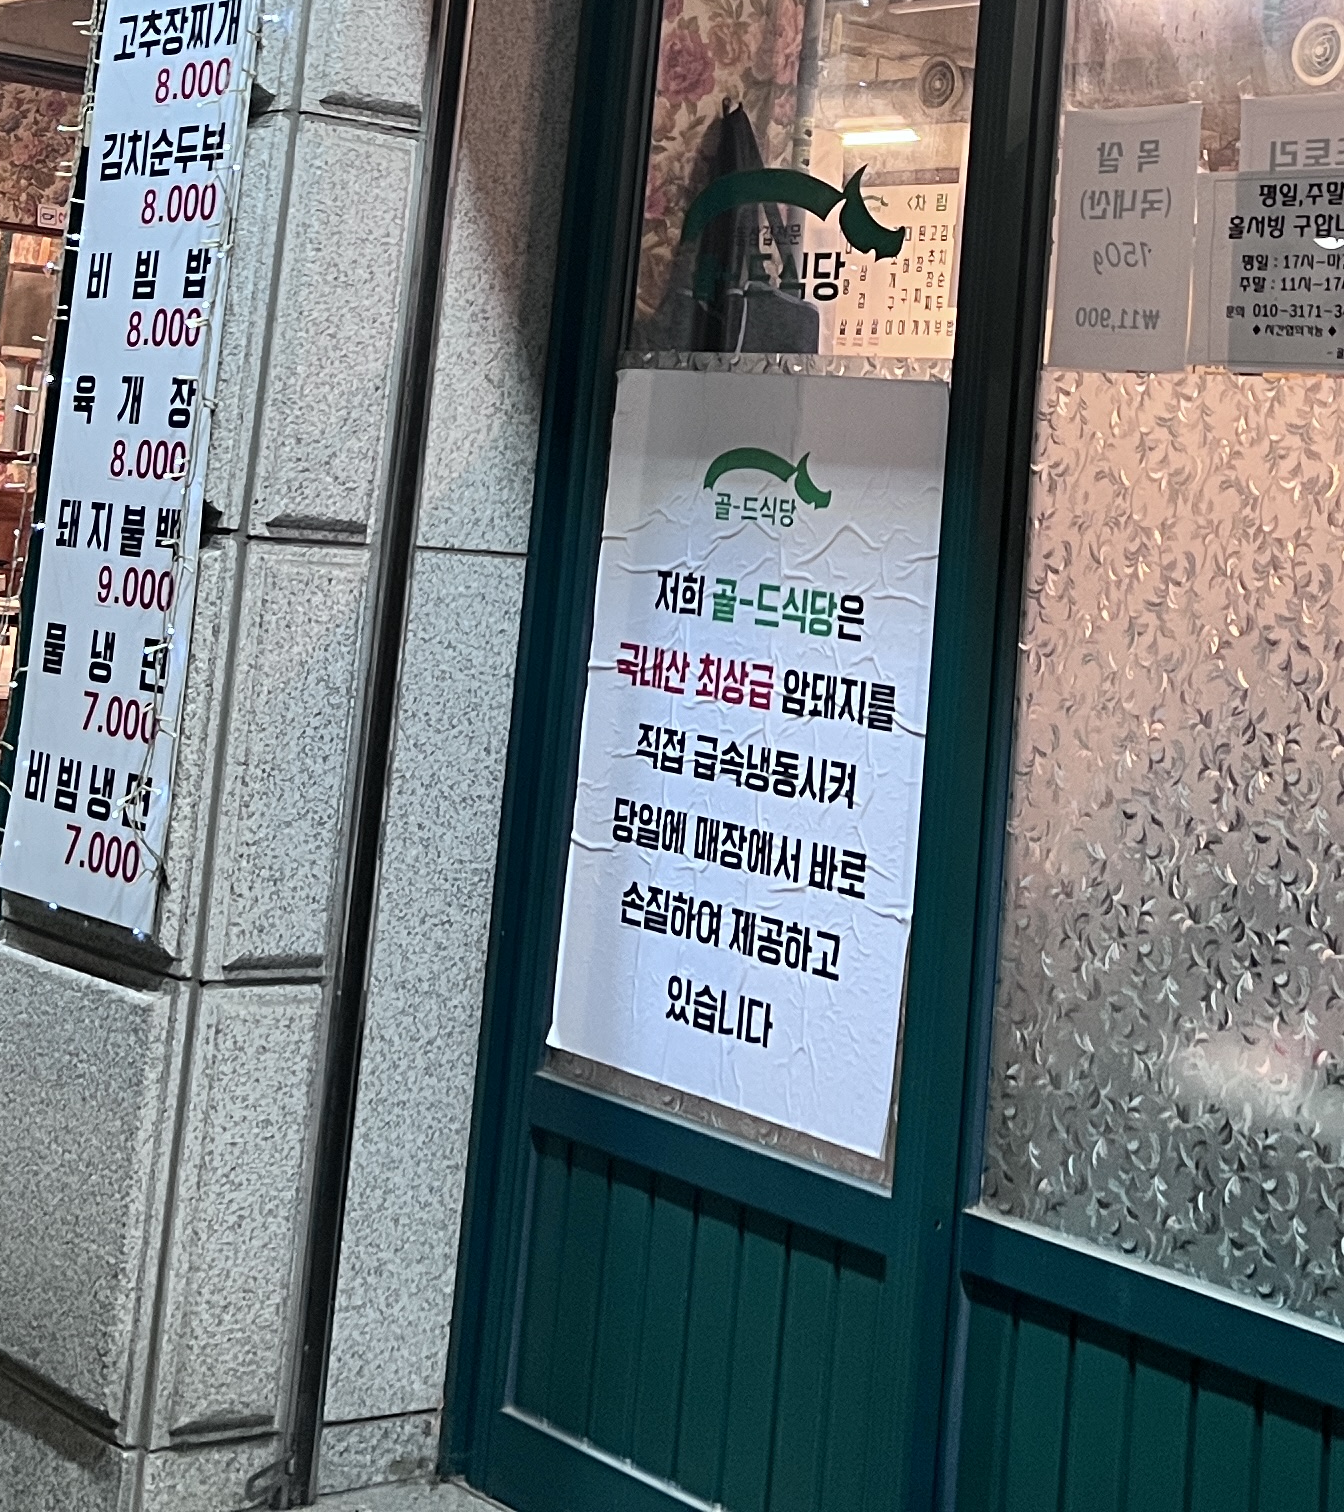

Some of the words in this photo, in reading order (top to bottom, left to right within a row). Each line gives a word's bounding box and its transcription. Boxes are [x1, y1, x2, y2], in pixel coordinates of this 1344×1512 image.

[155, 57, 233, 103] 8.000
[101, 123, 227, 181] 김치순두부
[141, 183, 217, 225] 8.000
[1228, 215, 1285, 239] 홀서빙
[1239, 276, 1267, 293] 주말
[1242, 254, 1268, 271] 평일
[110, 439, 187, 479] 8.000
[97, 565, 174, 613] 9.000
[655, 569, 704, 618] 저희
[616, 643, 689, 697] 국내산
[696, 651, 775, 713] 최상급
[783, 667, 897, 734] 암돼지를
[637, 724, 686, 774] 직접
[693, 735, 857, 810] 급속냉동시켜
[64, 824, 139, 883] 7.000
[613, 797, 687, 854] 당일에
[694, 814, 803, 885] 매장에서
[811, 844, 868, 901] 바로
[621, 885, 722, 948] 손질하여
[730, 907, 840, 982] 제공하고
[665, 976, 773, 1050] 있습니다
